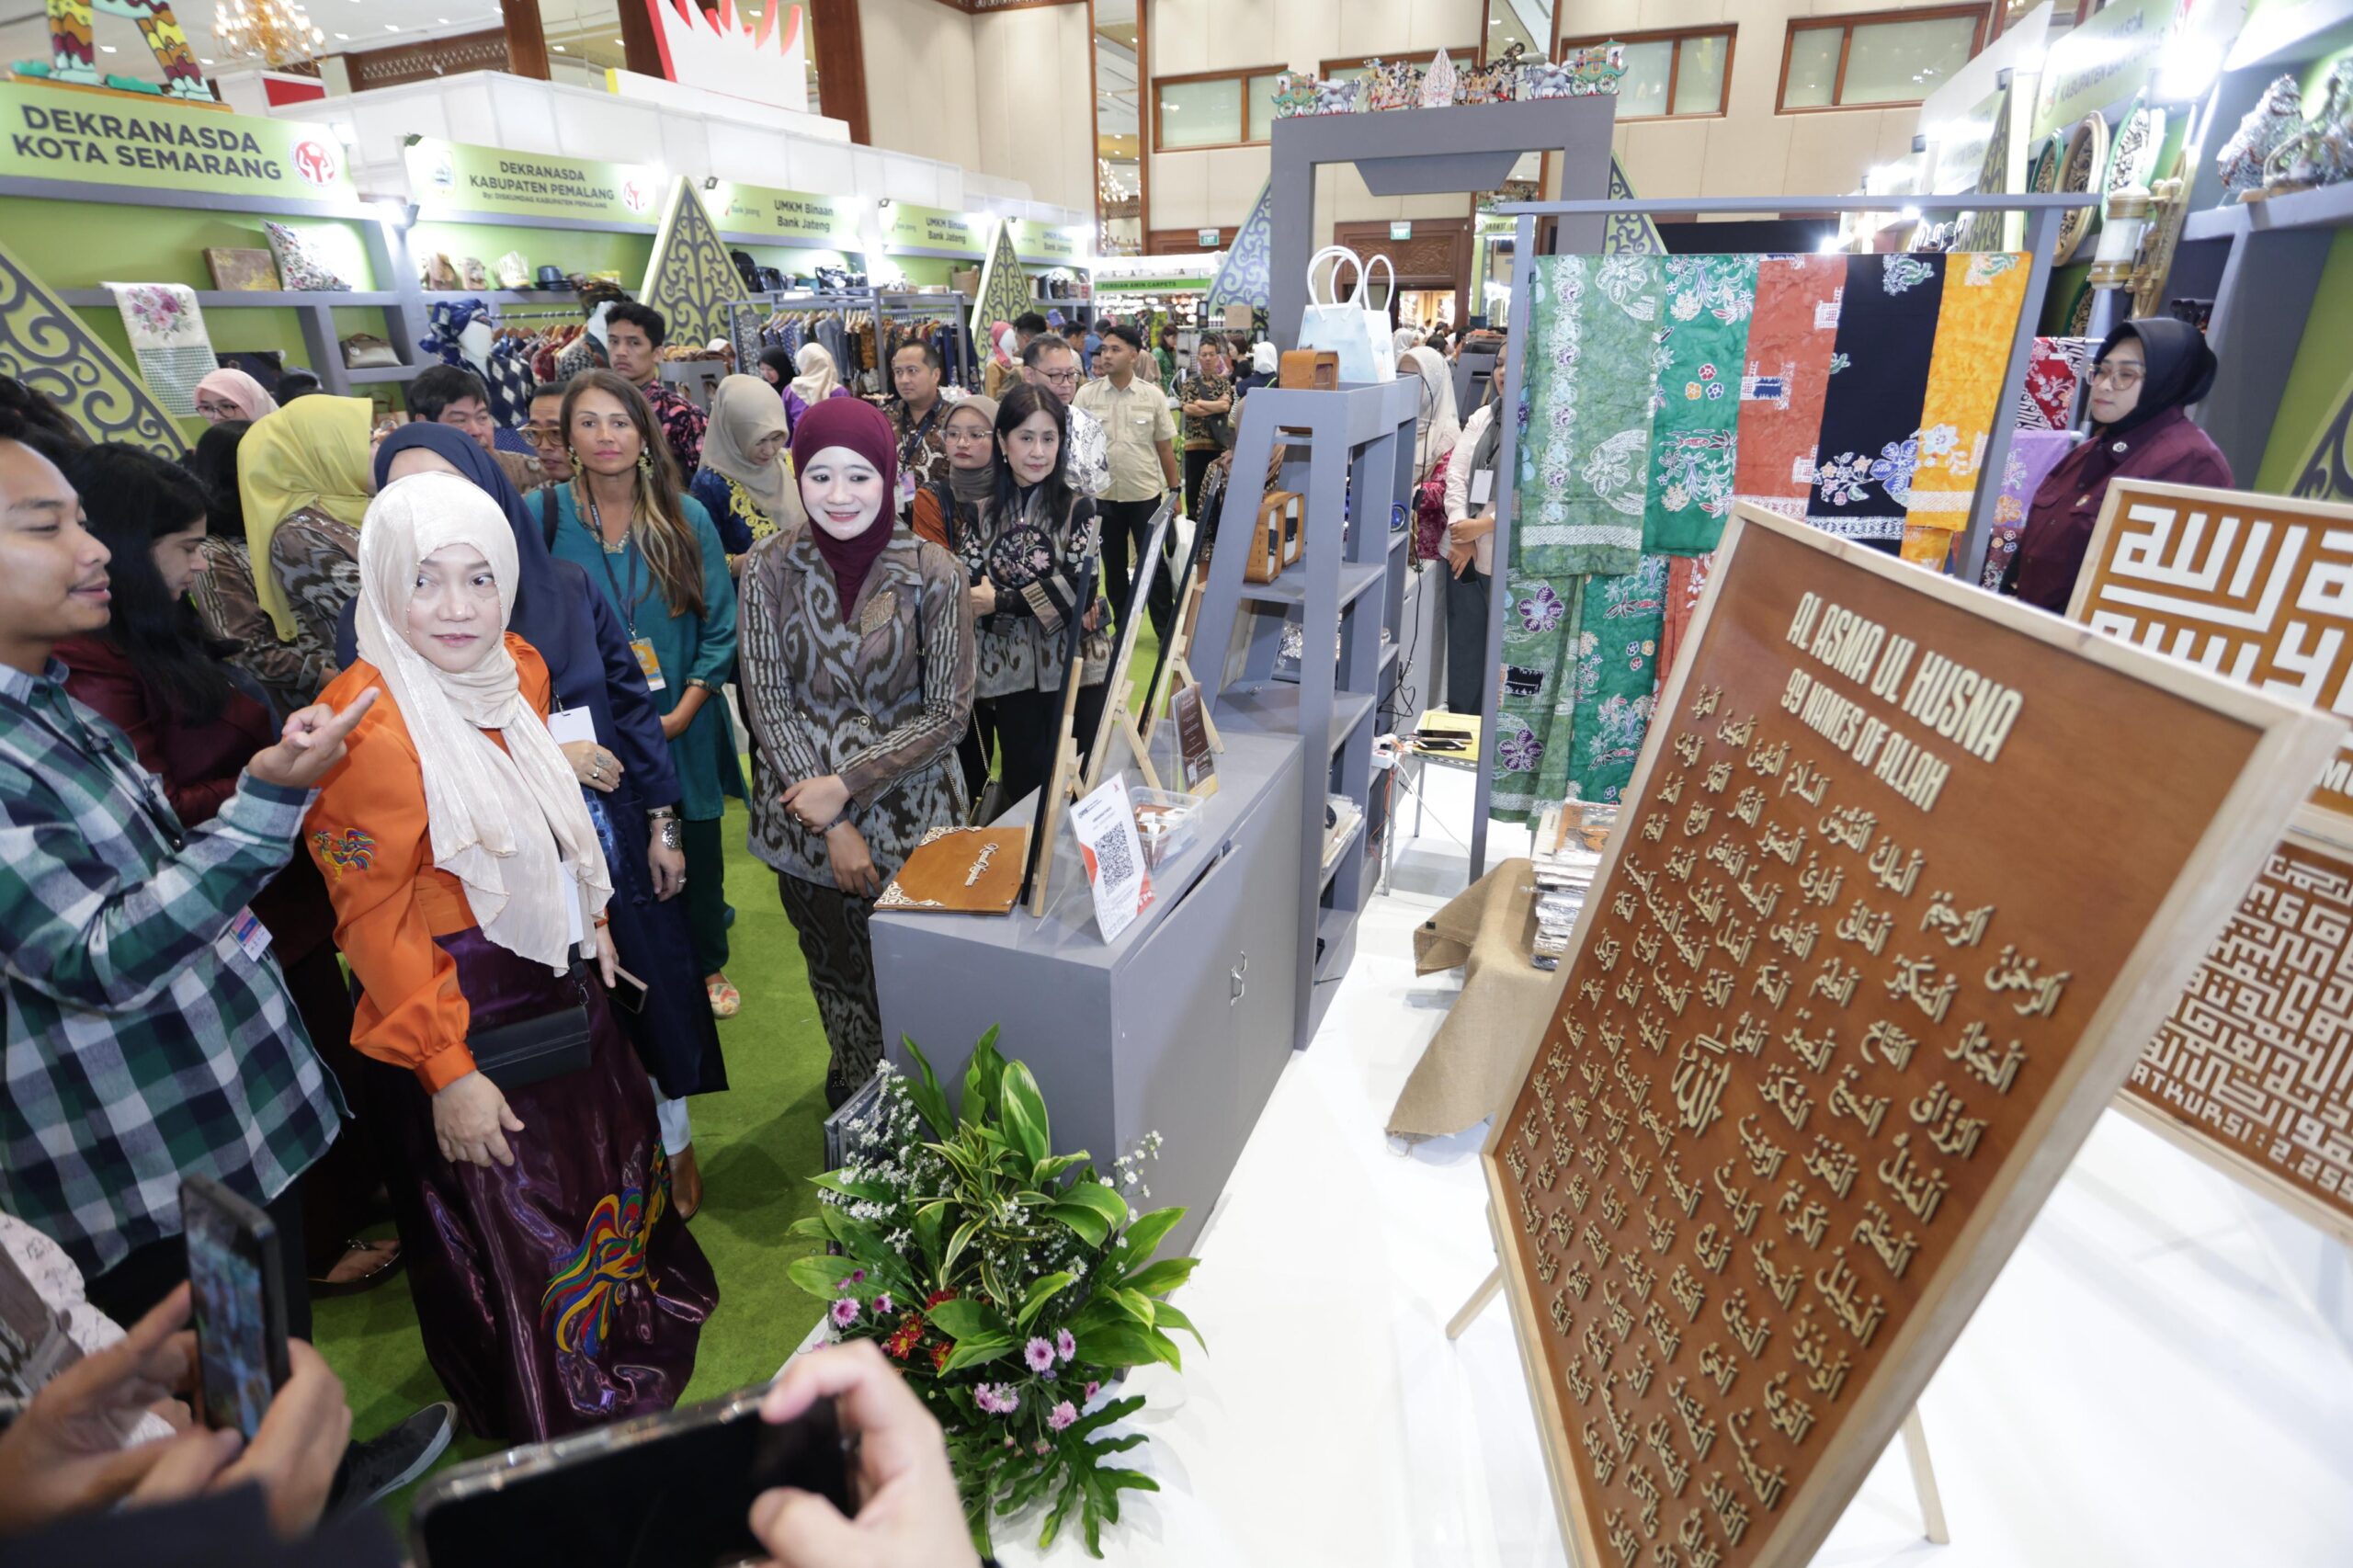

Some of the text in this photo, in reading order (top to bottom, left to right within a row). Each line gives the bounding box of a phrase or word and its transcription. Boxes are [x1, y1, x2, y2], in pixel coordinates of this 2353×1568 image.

[21, 104, 262, 154] DEKRANASDA
[12, 132, 108, 165] KOTA
[115, 145, 282, 180] SEMARANG
[499, 161, 585, 181] DEKRANASDA
[469, 175, 615, 200] KABUPATEN PEMALANG
[536, 197, 574, 207] KABUPATEN
[574, 199, 608, 209] PEMALANG
[774, 199, 834, 217] UMKM Binaan
[777, 216, 831, 233] Bank Jateng
[926, 218, 947, 229] UMKM
[927, 230, 967, 244] Bank Jateng
[1786, 591, 2022, 761] AL ASMA UL HUSNA
[1780, 668, 1949, 811] 99 NAMES OF ALLAH
